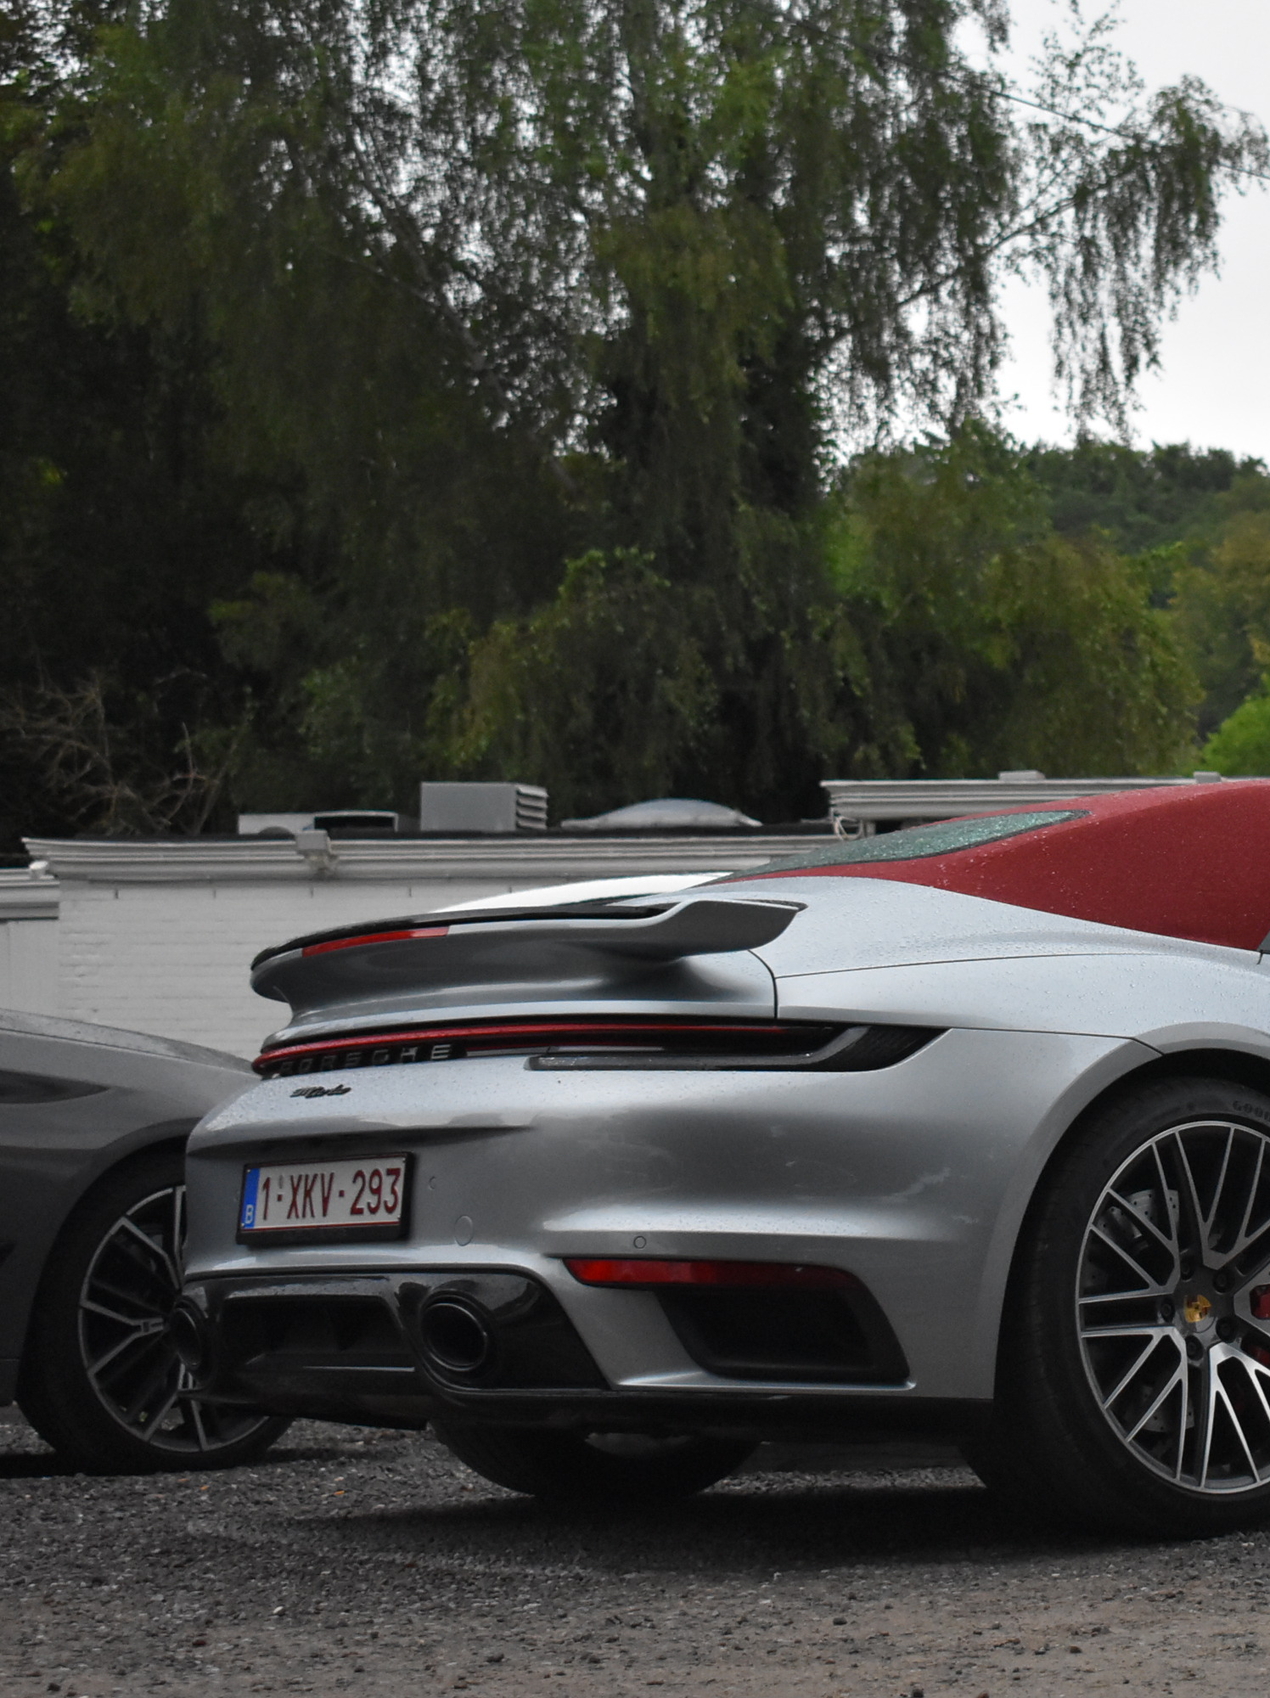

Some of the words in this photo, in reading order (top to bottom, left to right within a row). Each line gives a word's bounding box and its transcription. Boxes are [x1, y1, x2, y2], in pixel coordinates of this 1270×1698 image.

[280, 1044, 451, 1074] PORSCHE
[245, 1205, 254, 1224] B
[262, 1167, 402, 1221] 1-XKV-293
